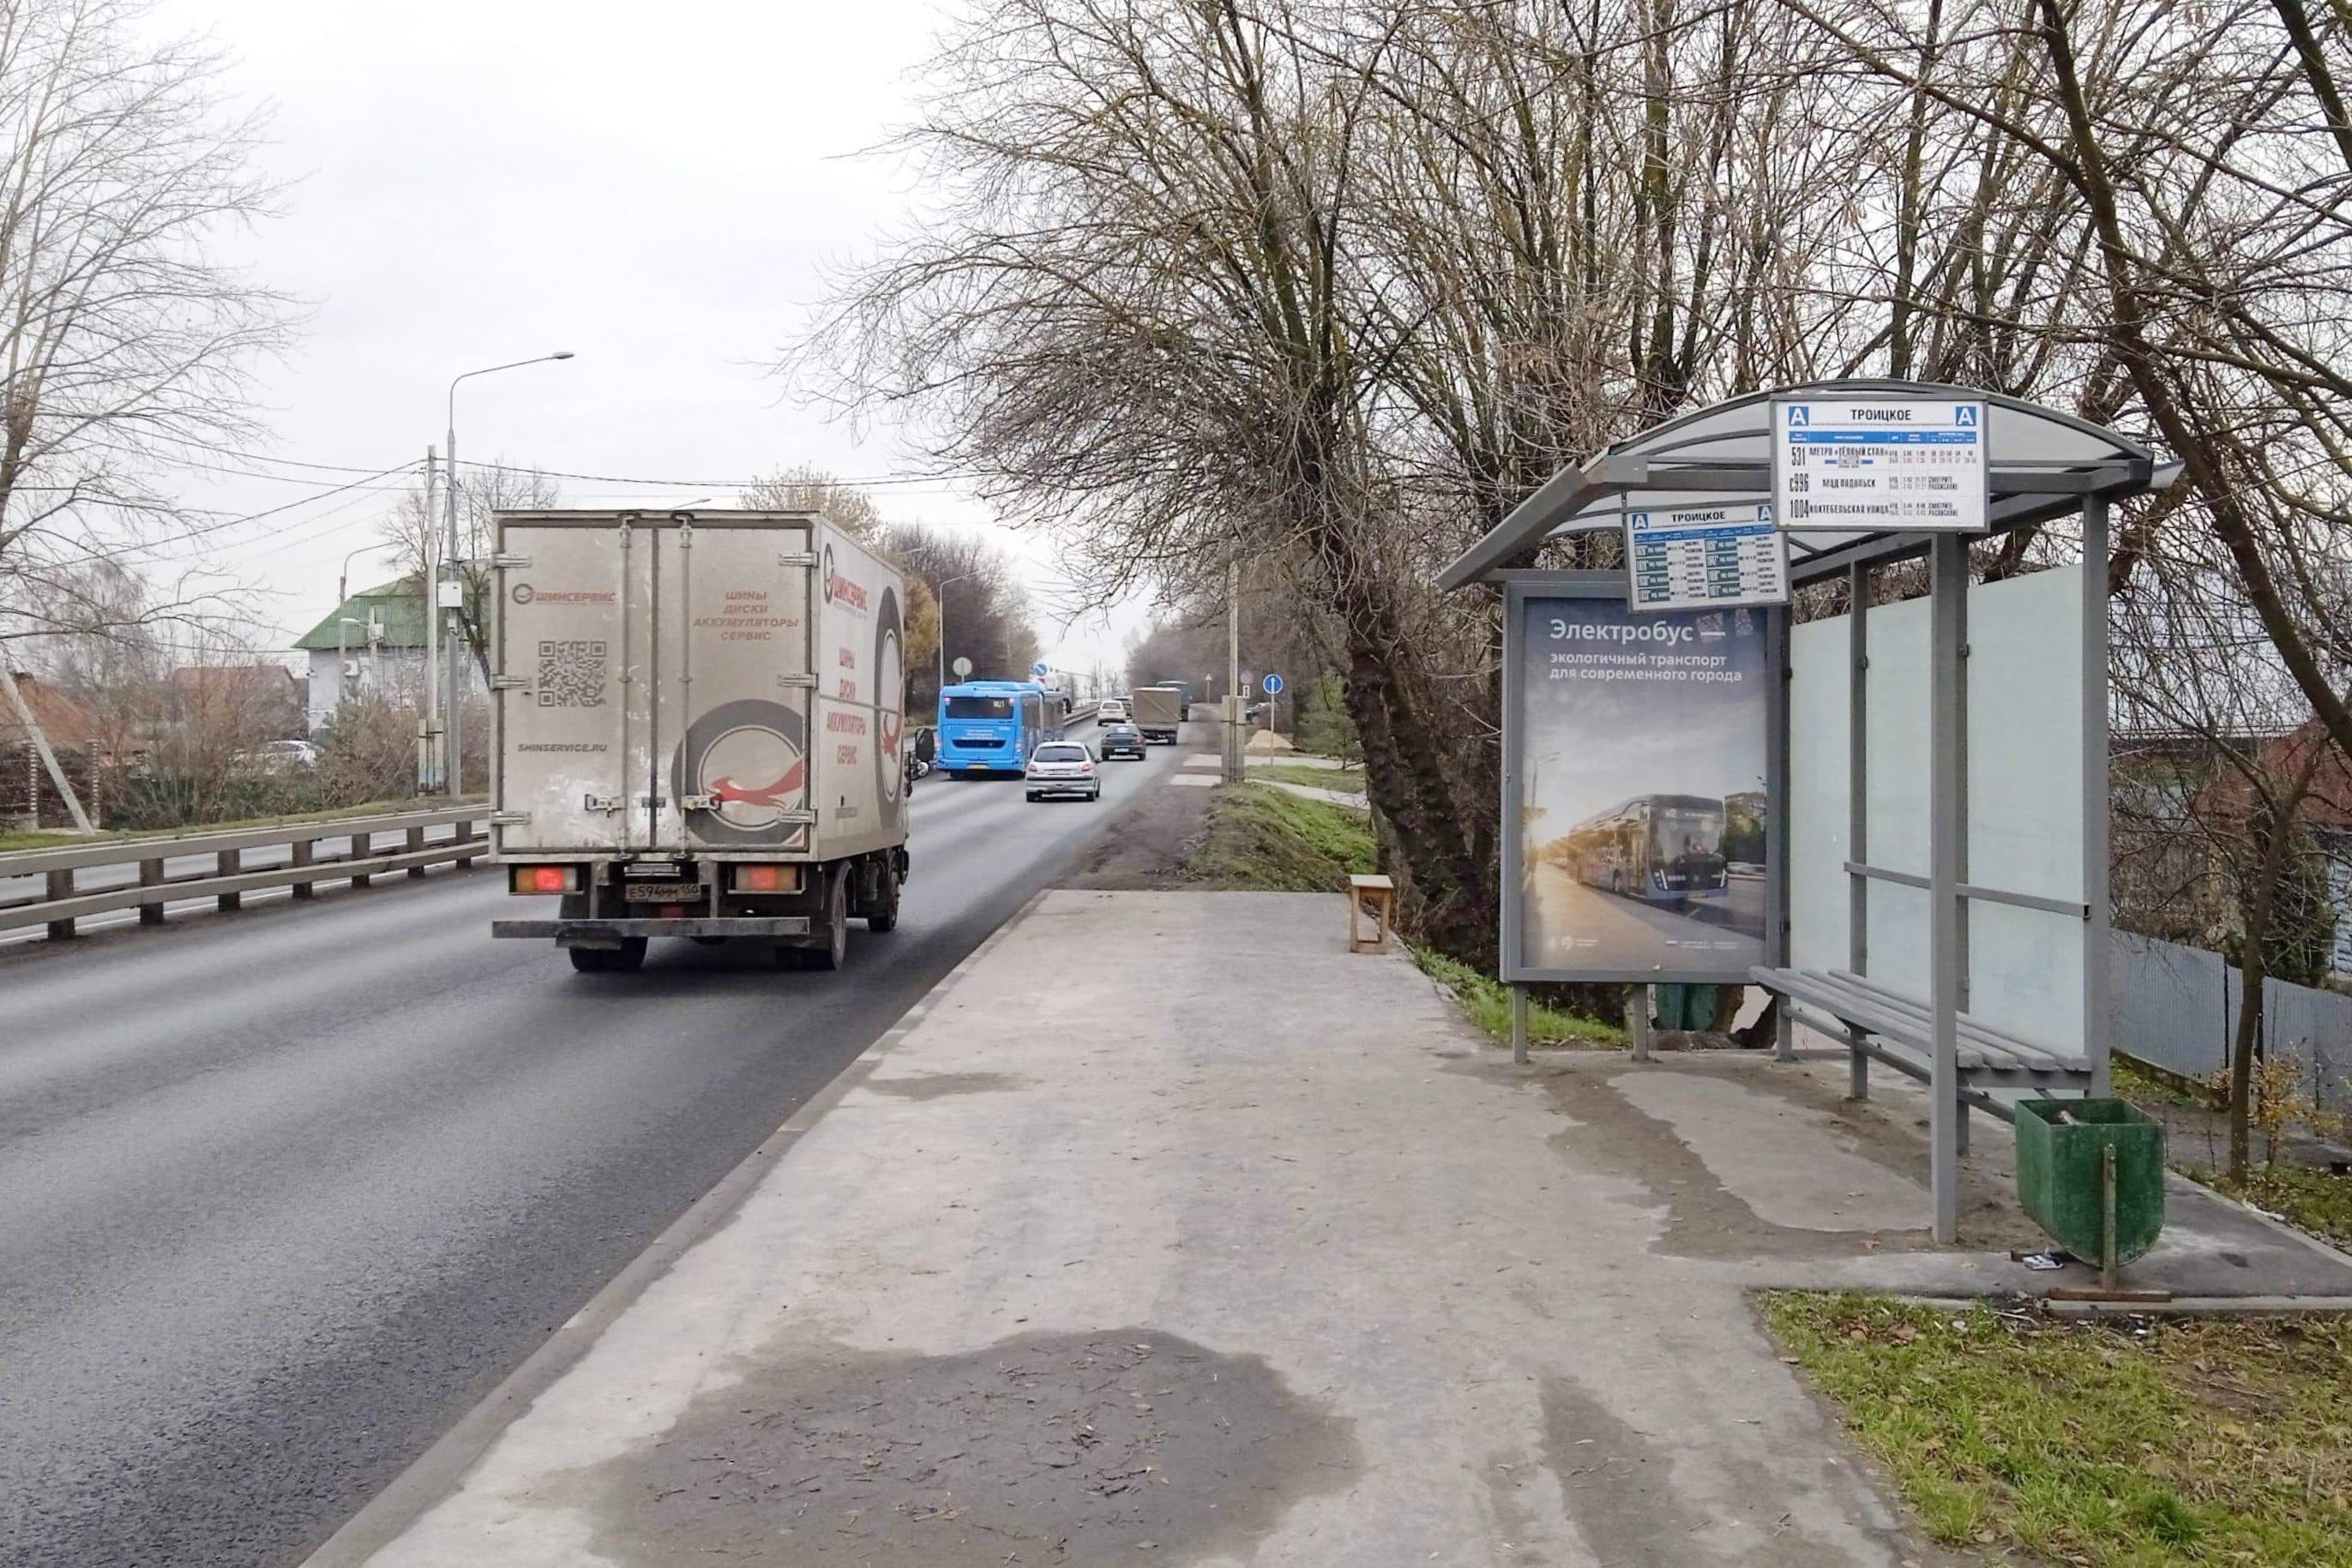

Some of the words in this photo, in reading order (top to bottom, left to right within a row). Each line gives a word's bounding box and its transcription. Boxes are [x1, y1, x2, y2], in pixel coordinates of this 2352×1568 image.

[1851, 409, 1911, 422] ТРОИЦКОЕ
[1791, 447, 1806, 466] 531
[1809, 448, 1833, 456] МЕТРО
[1790, 499, 1809, 518] 1004
[1672, 512, 1727, 522] ТРОИЦКОЕ
[725, 591, 767, 600] ШИНЫ
[723, 604, 768, 614] ДИСКИ
[694, 618, 799, 628] АККУМУЛЯТОРЫ
[721, 631, 772, 640] СЕРВИС
[1550, 619, 1693, 645] Электробус
[1550, 652, 1646, 665] экологичный
[1650, 655, 1727, 668] транспорт
[1549, 669, 1576, 680] для
[1580, 670, 1687, 682] современного
[1691, 672, 1742, 683] города
[518, 743, 607, 753] SHINSERVICE.RU
